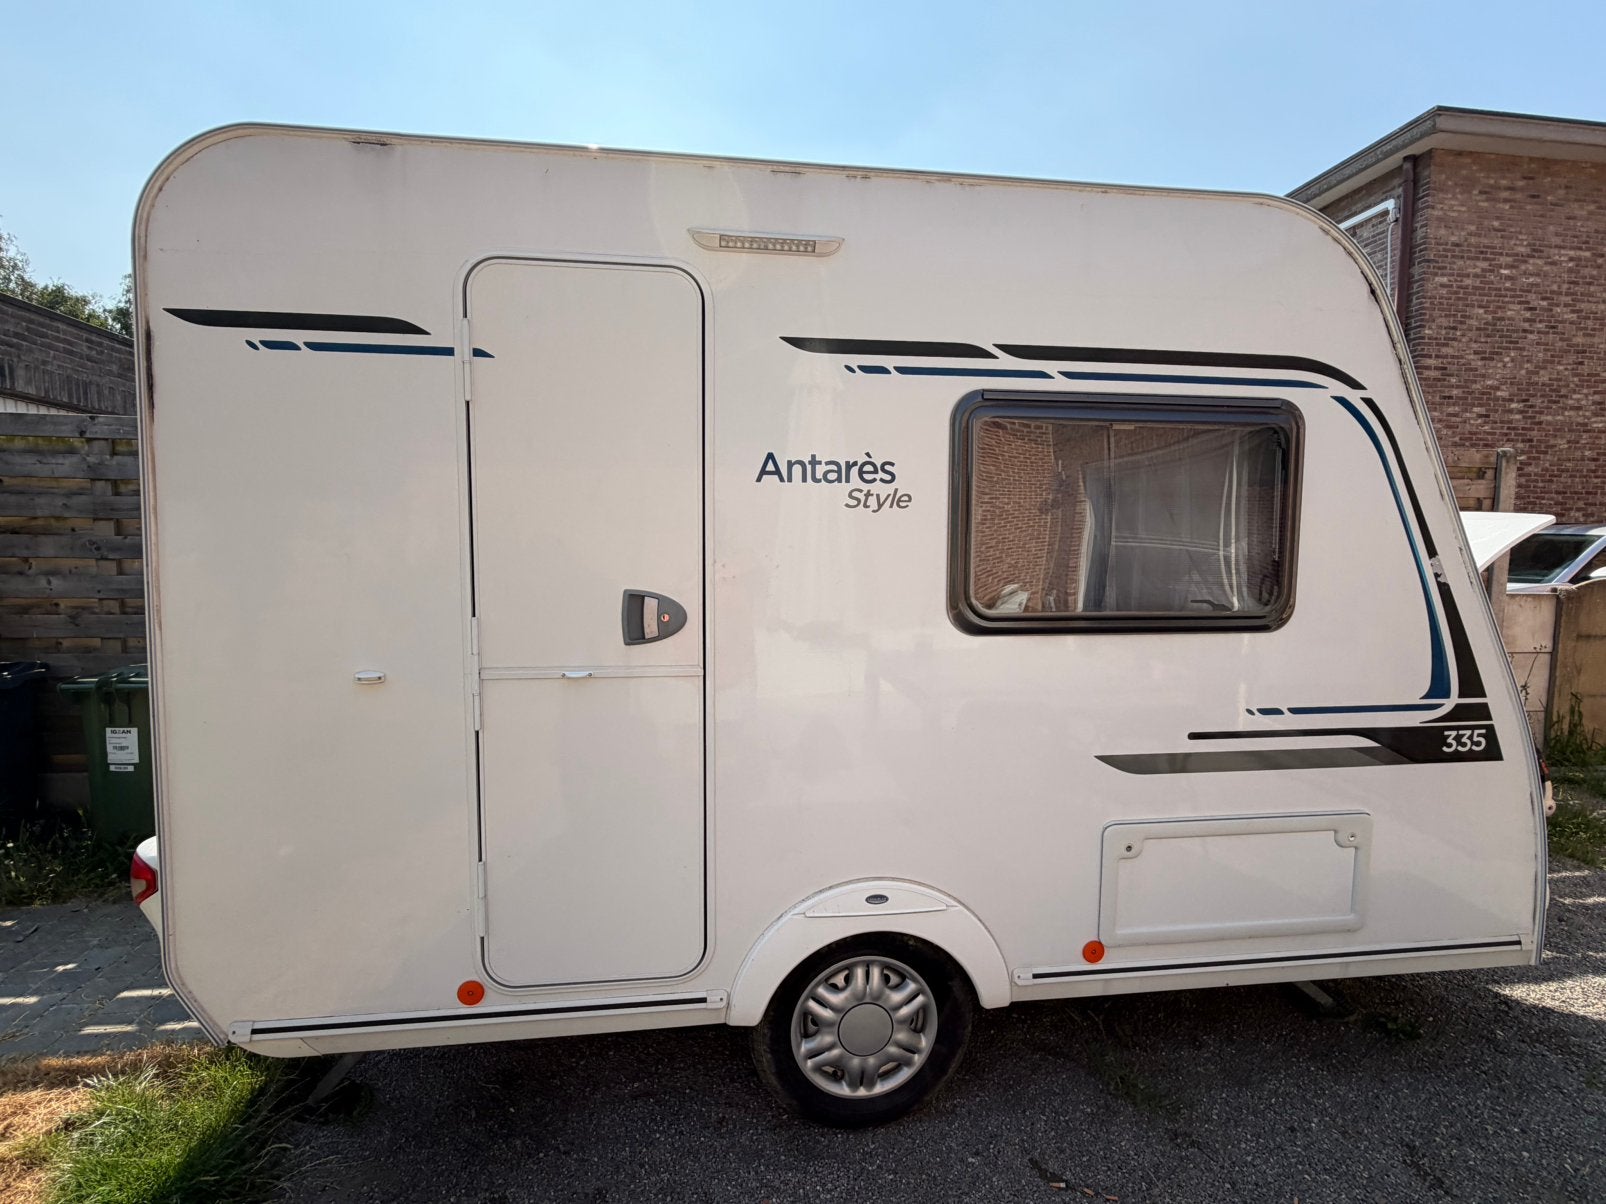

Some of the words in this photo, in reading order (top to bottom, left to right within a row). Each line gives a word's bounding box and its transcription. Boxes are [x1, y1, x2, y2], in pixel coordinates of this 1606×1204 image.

[755, 451, 896, 484] Antarès
[844, 487, 913, 513] Style
[1441, 729, 1487, 753] 335
